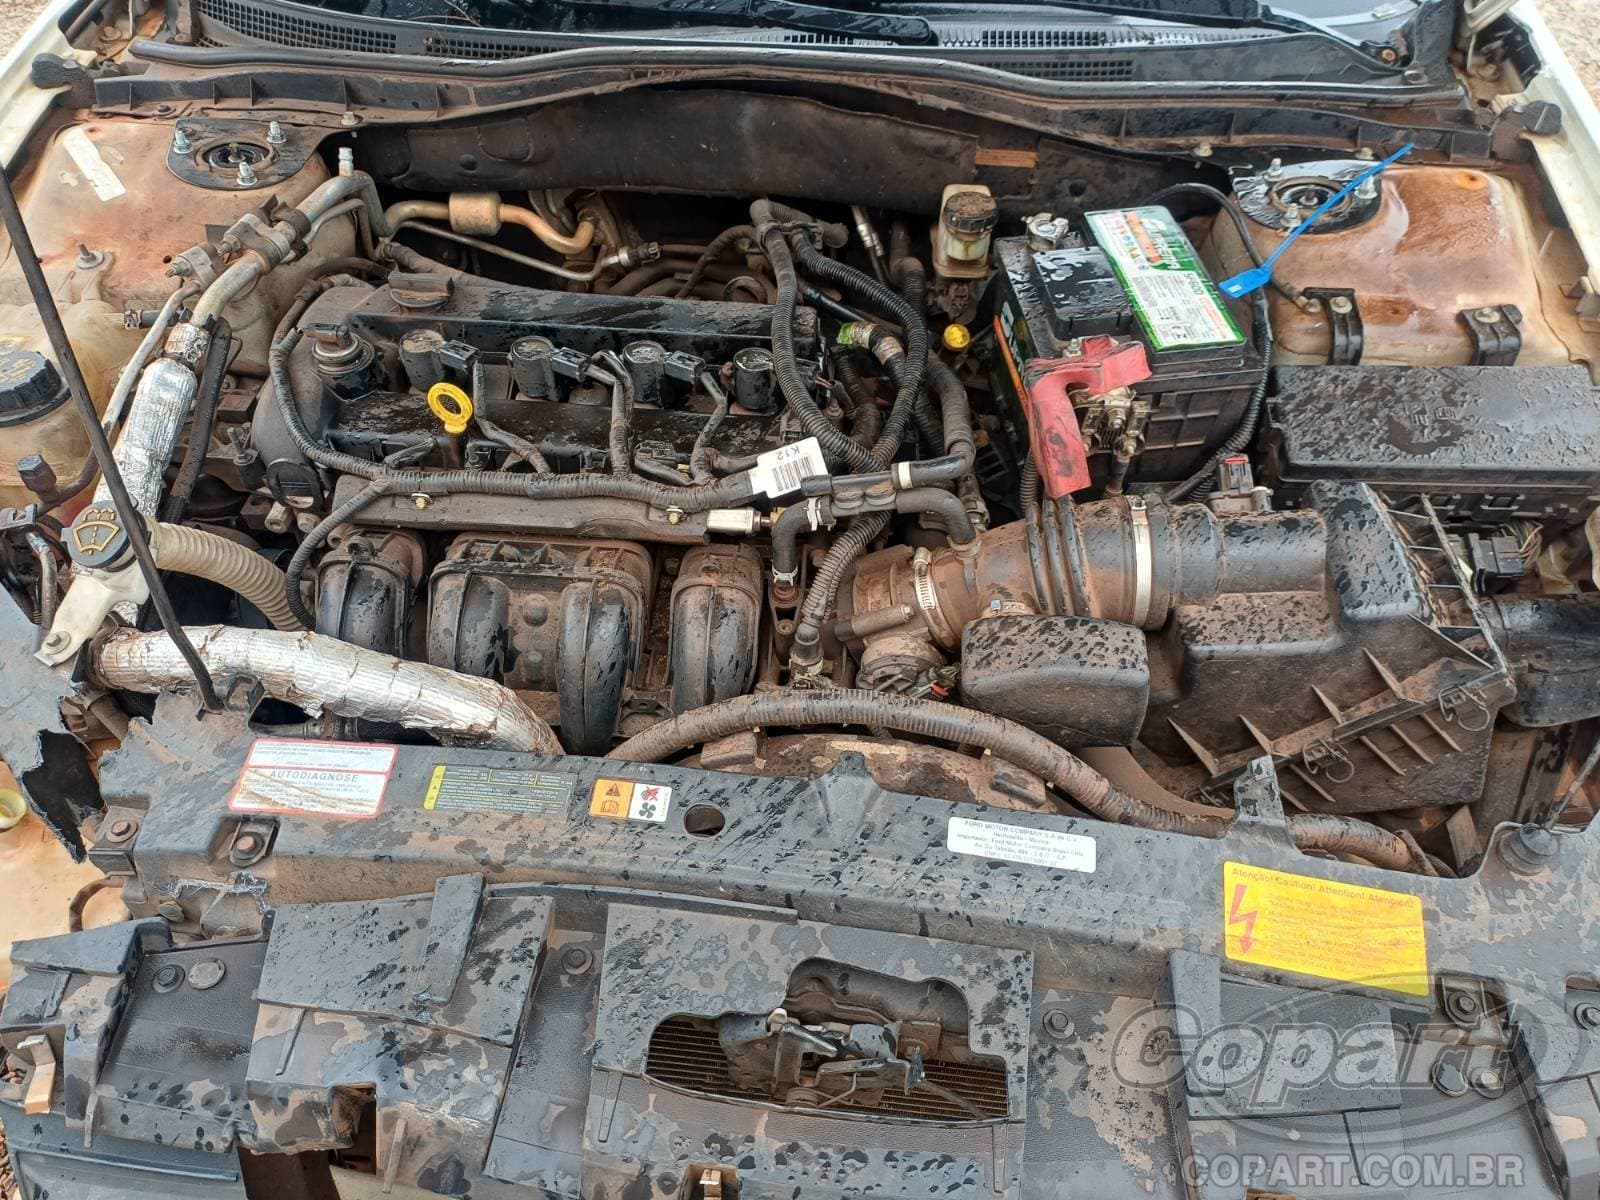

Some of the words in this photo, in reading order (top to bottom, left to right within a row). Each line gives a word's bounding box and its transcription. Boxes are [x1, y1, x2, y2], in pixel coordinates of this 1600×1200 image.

[270, 770, 360, 783] AUTODIAGNOSE
[985, 823, 1008, 831] MOTOR
[1009, 827, 1042, 836] COMPANY
[1275, 876, 1315, 890] Caution!
[1319, 884, 1364, 899] Attention!
